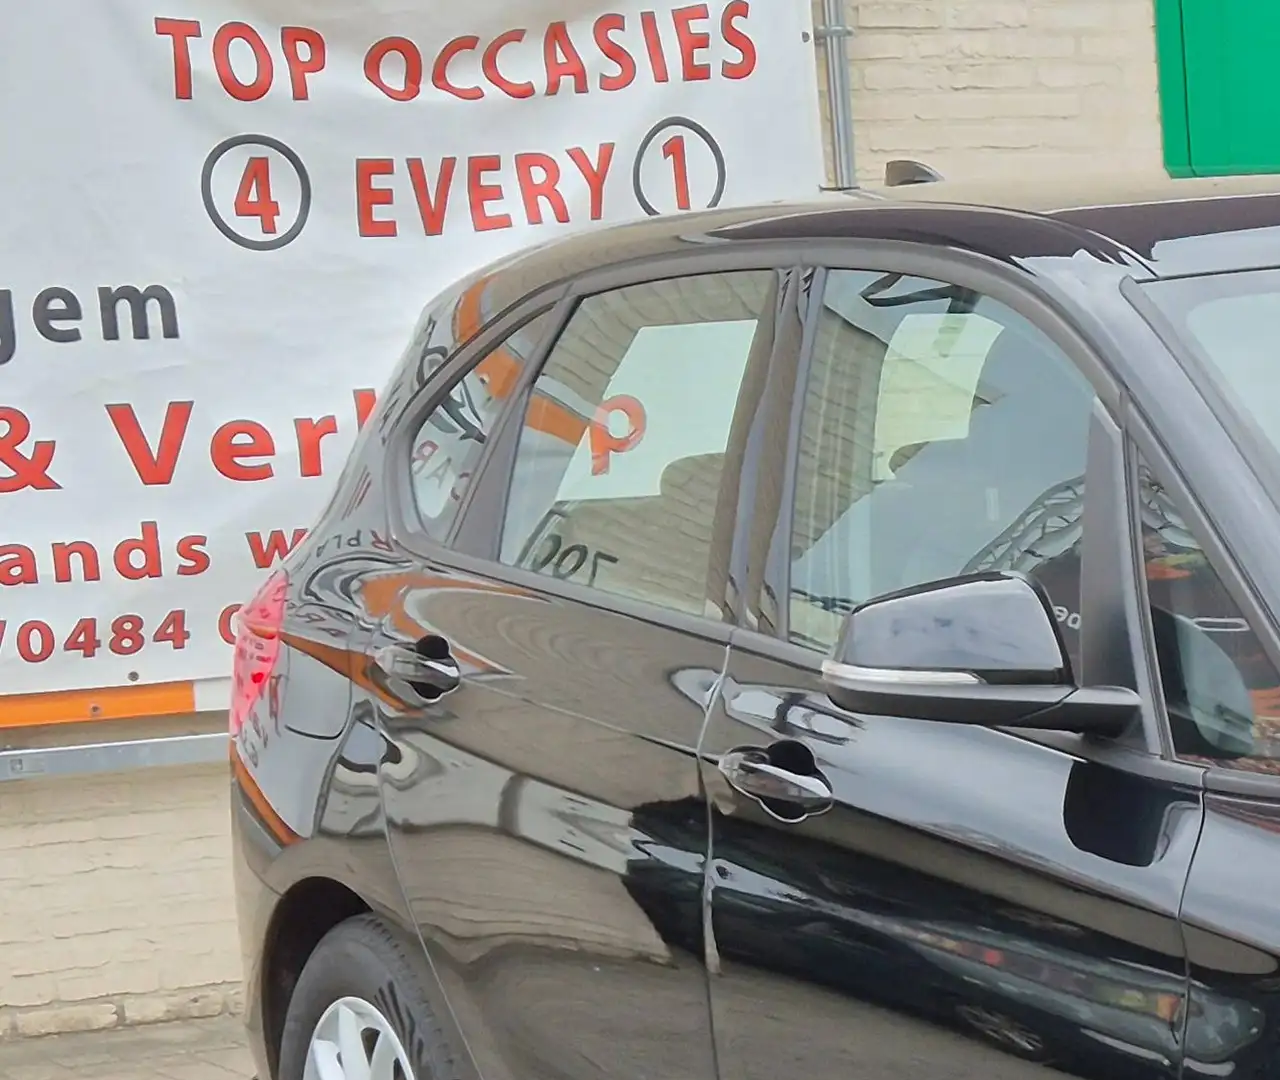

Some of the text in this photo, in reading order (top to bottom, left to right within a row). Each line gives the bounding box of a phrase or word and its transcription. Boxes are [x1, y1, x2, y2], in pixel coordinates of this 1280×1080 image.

[155, 0, 757, 101] TOP OCCASIES
[234, 135, 691, 237] 4 EVERY 1
[0, 406, 64, 494] &
